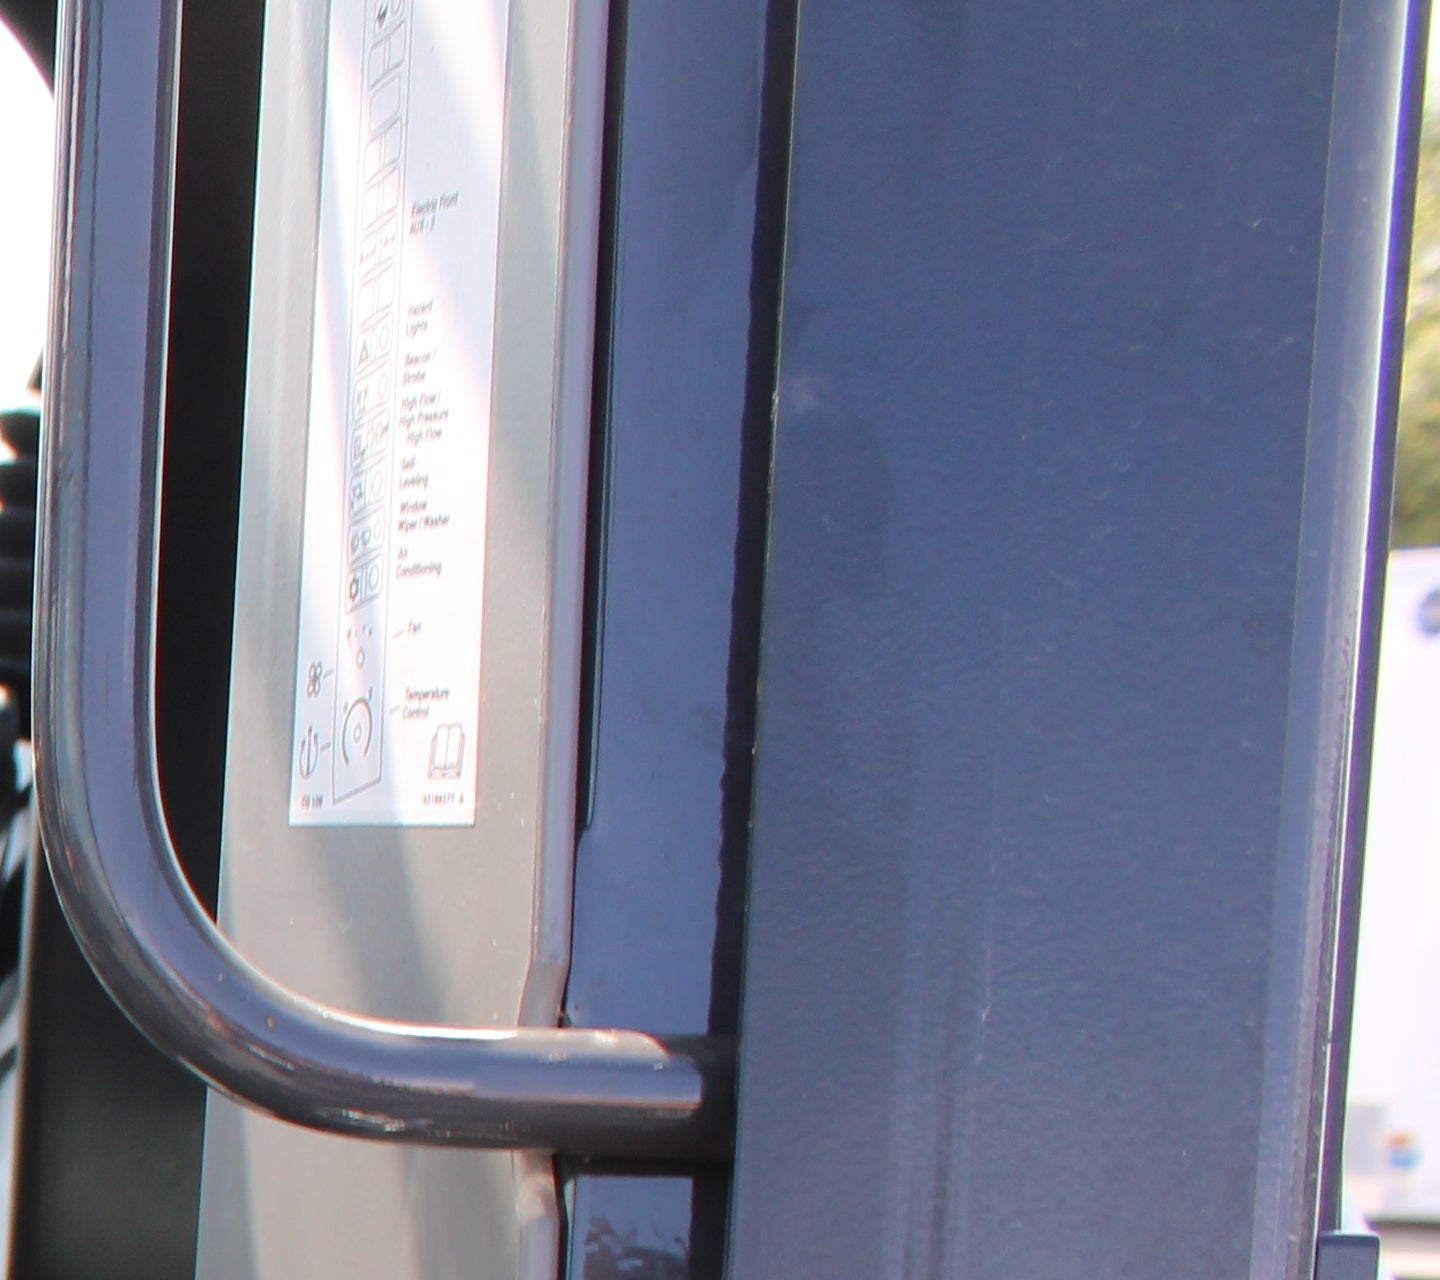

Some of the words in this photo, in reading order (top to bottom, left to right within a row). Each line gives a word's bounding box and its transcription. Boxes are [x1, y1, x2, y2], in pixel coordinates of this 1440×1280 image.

[407, 619, 422, 635] Fan
[405, 686, 450, 701] Temperature
[402, 704, 430, 720] Control
